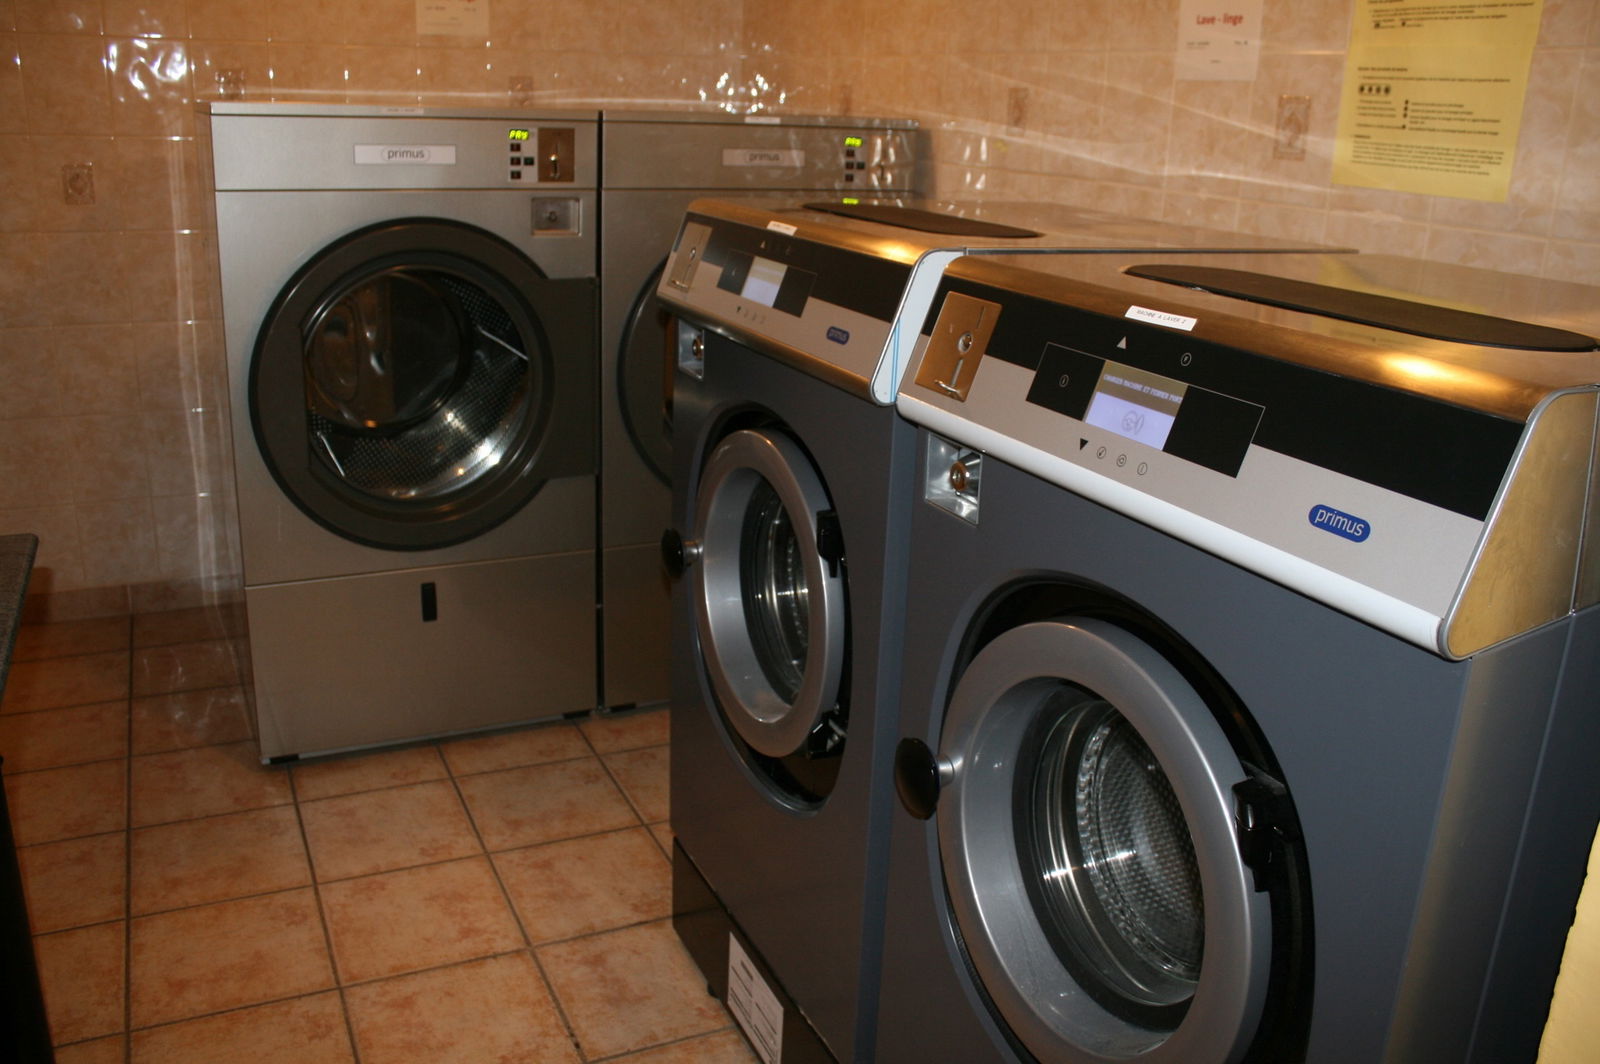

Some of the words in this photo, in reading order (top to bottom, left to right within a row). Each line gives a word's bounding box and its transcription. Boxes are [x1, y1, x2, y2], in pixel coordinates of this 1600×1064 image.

[1196, 15, 1216, 25] Lave
[1222, 13, 1244, 26] linge
[387, 149, 425, 160] primus
[748, 152, 780, 162] primus
[1314, 509, 1364, 536] primus
